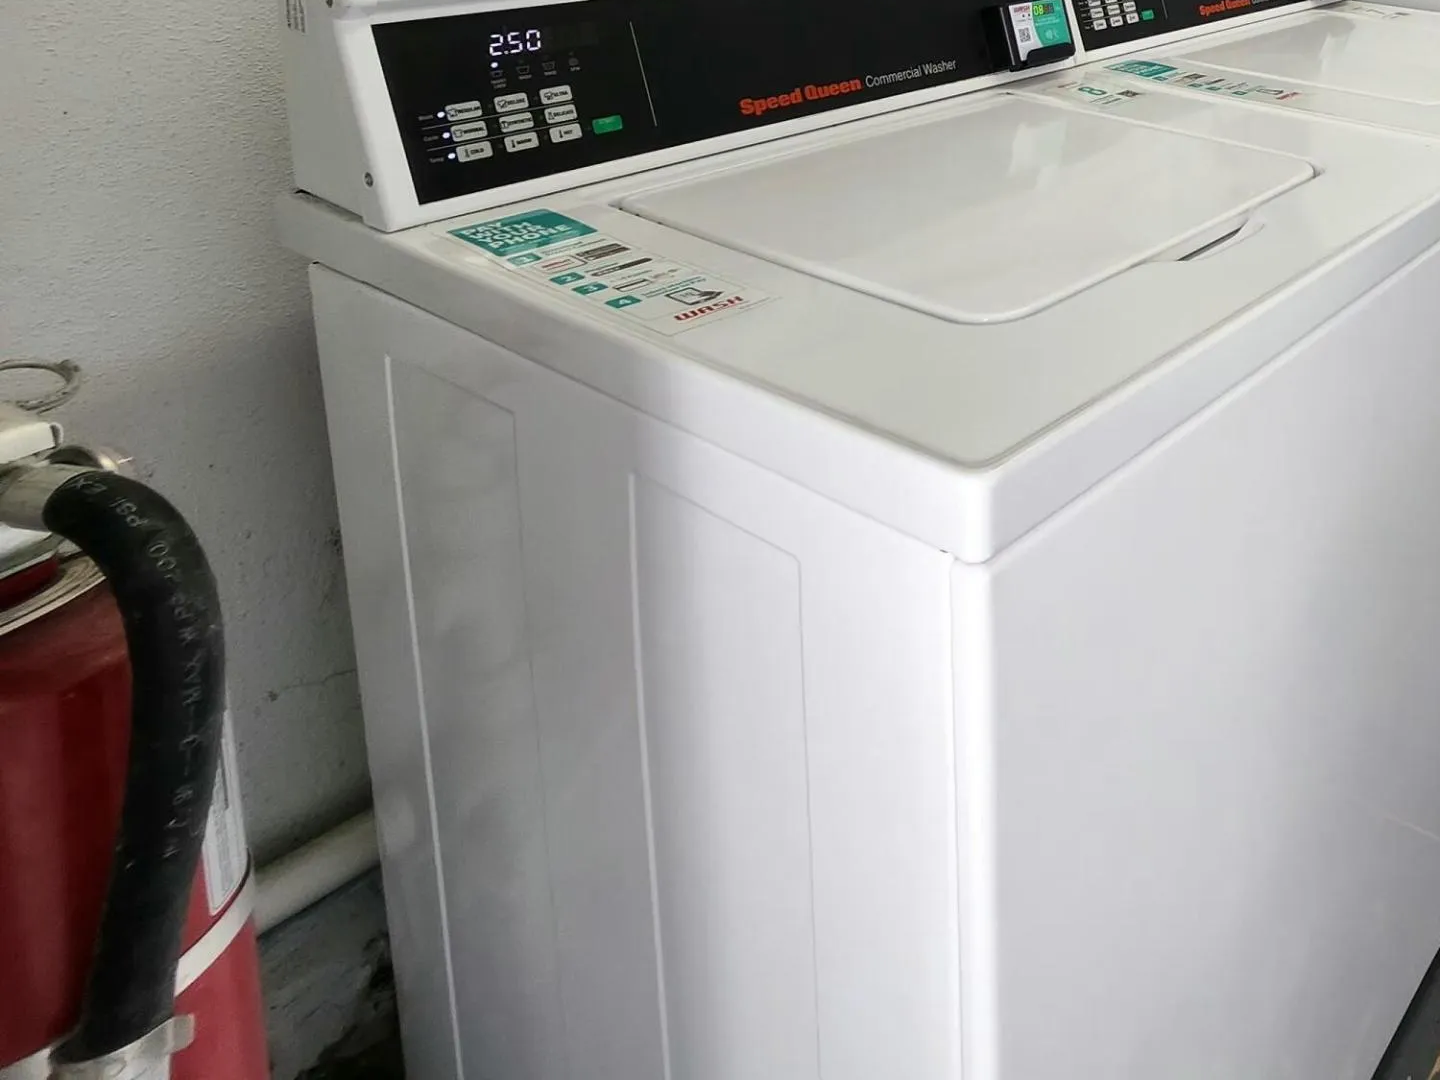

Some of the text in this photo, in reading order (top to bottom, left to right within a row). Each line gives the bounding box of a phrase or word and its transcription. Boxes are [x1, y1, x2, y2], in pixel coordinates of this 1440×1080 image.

[1200, 0, 1225, 16] Speed
[489, 29, 541, 57] 2.50
[739, 59, 958, 116] Speed Queen Commercial Washer
[477, 224, 545, 244] YOUR
[487, 224, 573, 249] PHONE
[673, 295, 743, 321] WASH
